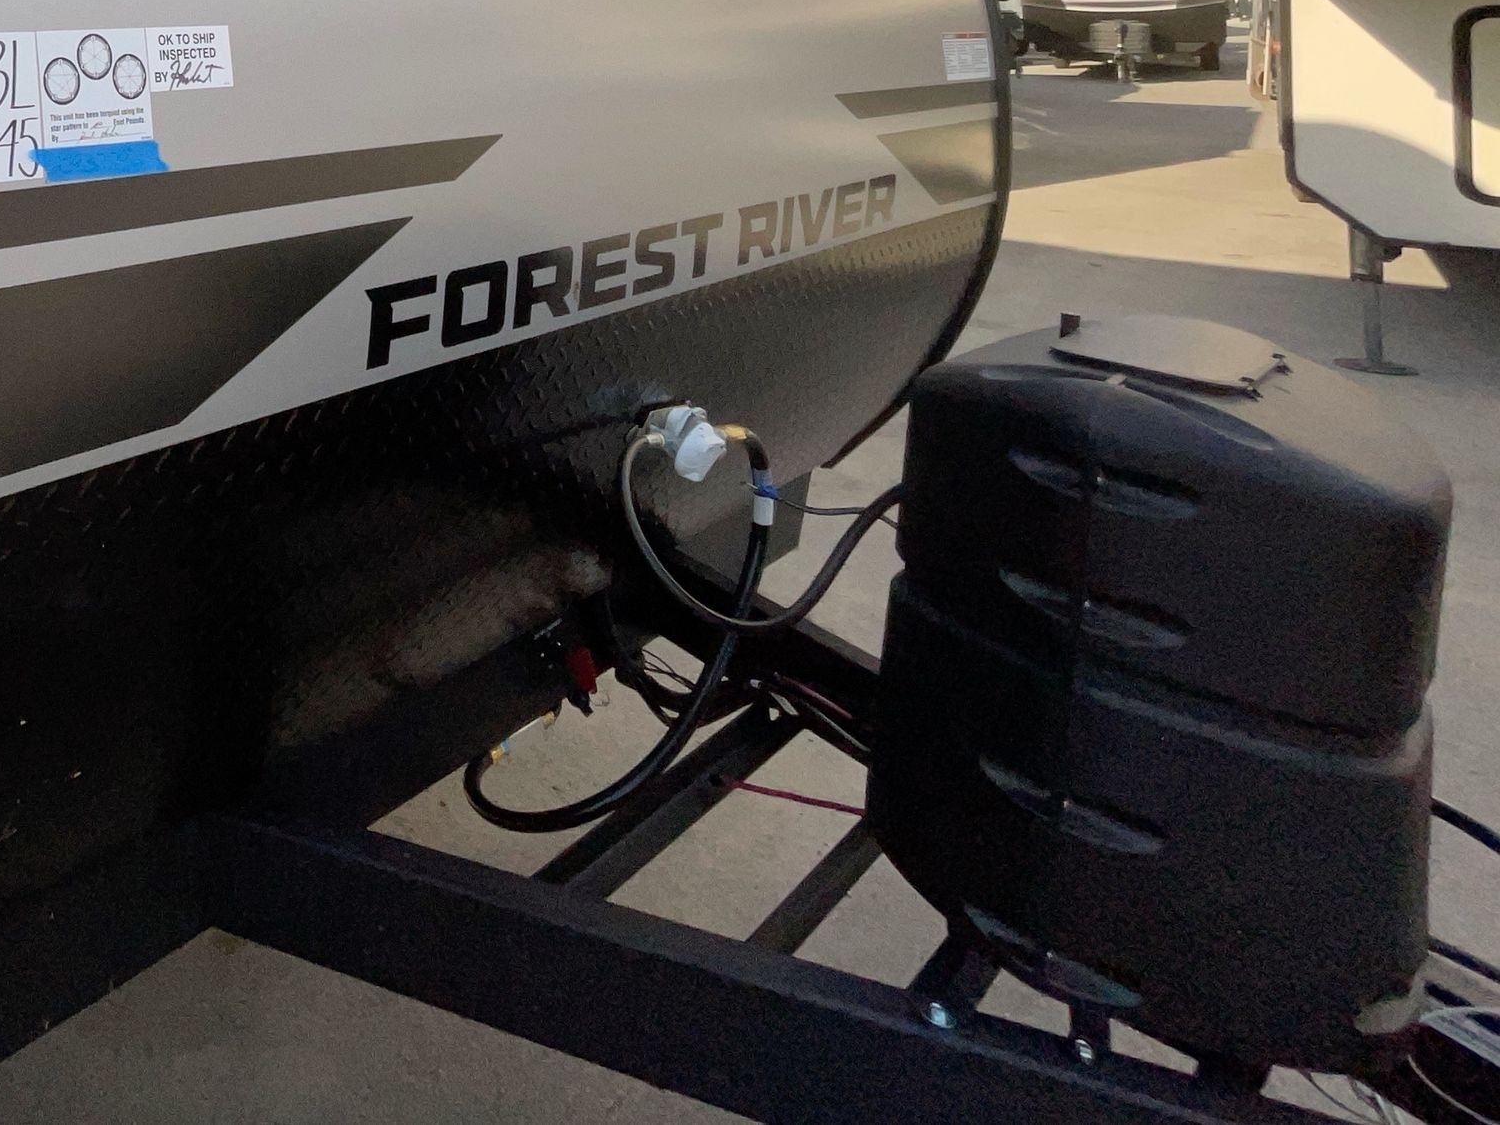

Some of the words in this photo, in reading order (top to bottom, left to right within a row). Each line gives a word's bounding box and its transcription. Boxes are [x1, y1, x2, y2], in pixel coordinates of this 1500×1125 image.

[158, 34, 174, 45] OK
[176, 34, 190, 44] TO
[192, 33, 215, 44] SHIP
[159, 47, 216, 61] INSPECTED
[154, 71, 168, 83] BY
[365, 212, 723, 370] FOREST
[736, 174, 896, 266] RIVER
